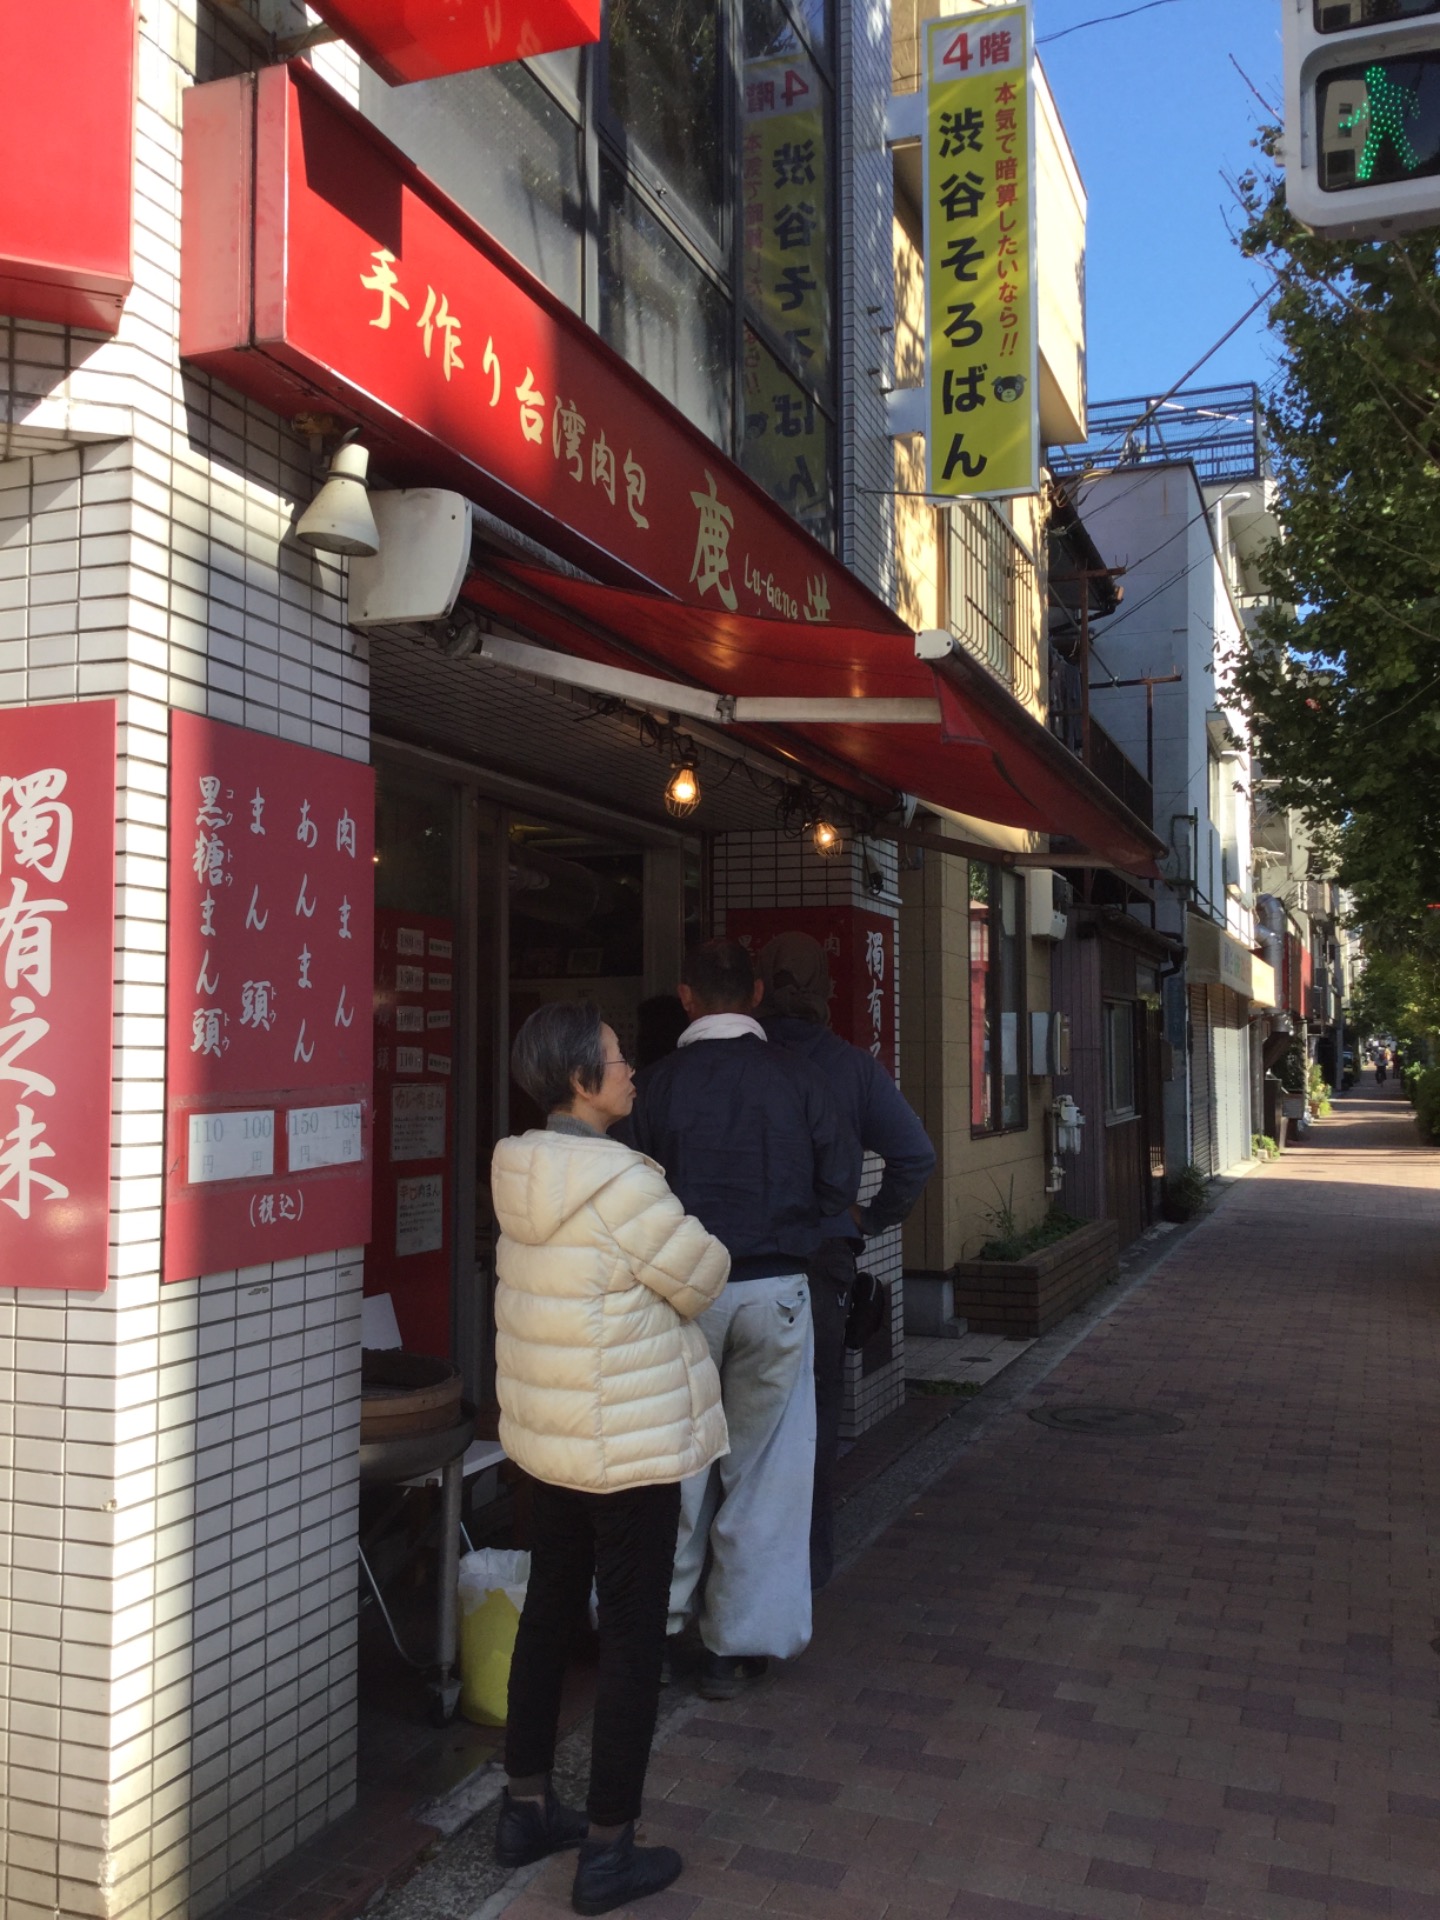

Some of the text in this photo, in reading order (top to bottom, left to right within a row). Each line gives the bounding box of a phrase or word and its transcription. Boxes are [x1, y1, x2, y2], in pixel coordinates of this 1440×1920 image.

[942, 30, 1012, 71] 4階
[938, 107, 988, 481] 渋谷そろばん
[359, 248, 651, 531] 手作り台湾肉包
[294, 798, 318, 1062] あんまん
[334, 808, 356, 1027] 肉まん
[193, 1118, 224, 1143] 110
[243, 1115, 271, 1140] 100
[292, 1111, 319, 1136] 150
[249, 1190, 304, 1228] (税込)
